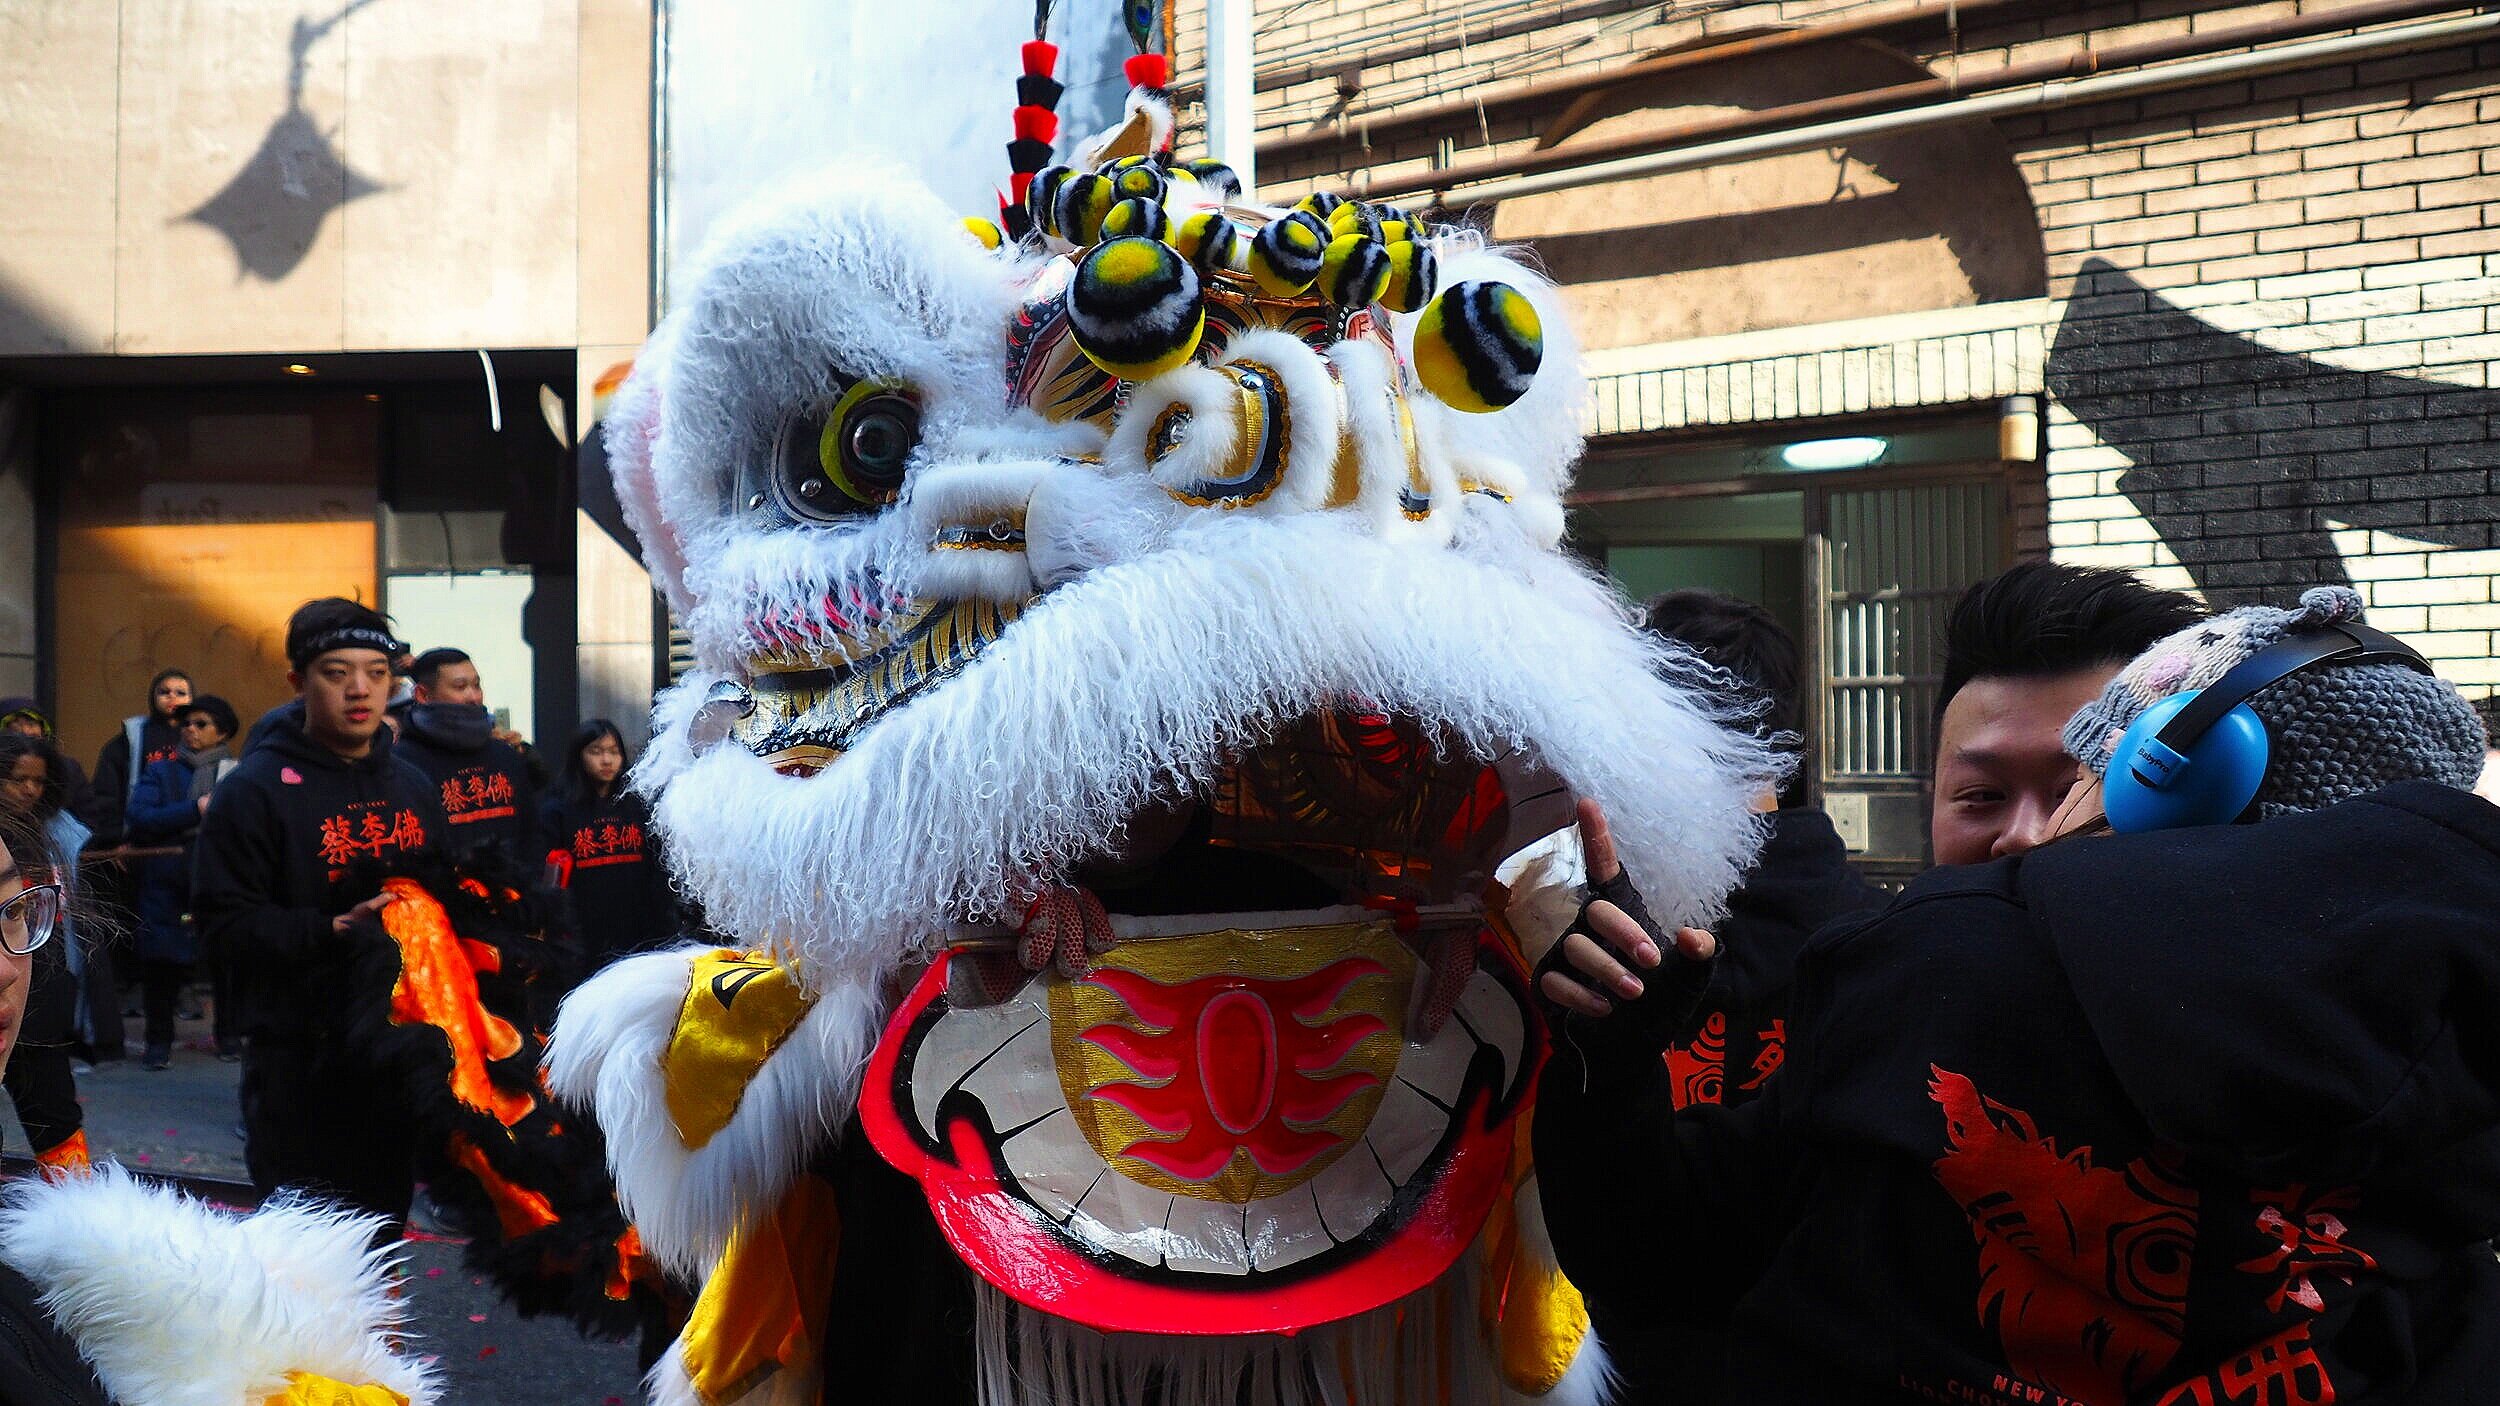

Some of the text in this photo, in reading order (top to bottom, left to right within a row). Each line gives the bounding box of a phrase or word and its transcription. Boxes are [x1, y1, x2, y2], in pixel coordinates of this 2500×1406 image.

[441, 772, 513, 812] 蔡李佛
[318, 808, 425, 865] 蔡李佛
[1993, 1374, 2045, 1404] NEW
